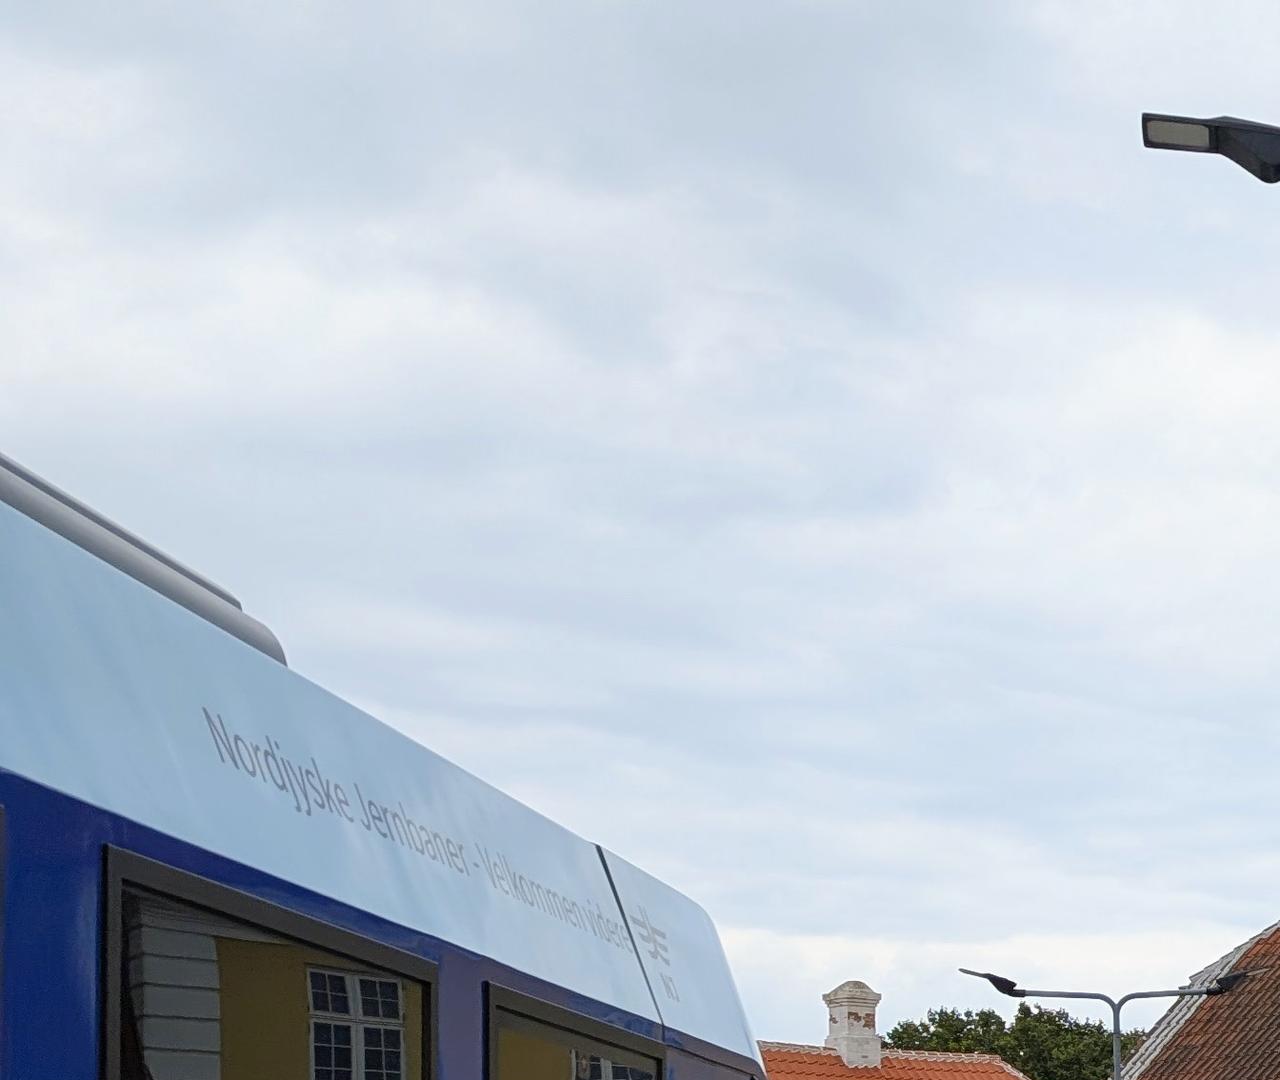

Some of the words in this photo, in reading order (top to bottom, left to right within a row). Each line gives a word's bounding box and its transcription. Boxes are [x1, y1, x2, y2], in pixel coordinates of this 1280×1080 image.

[201, 706, 354, 823] Nordjyske
[353, 782, 471, 877] Jernbaner
[474, 842, 588, 931] Velkommen
